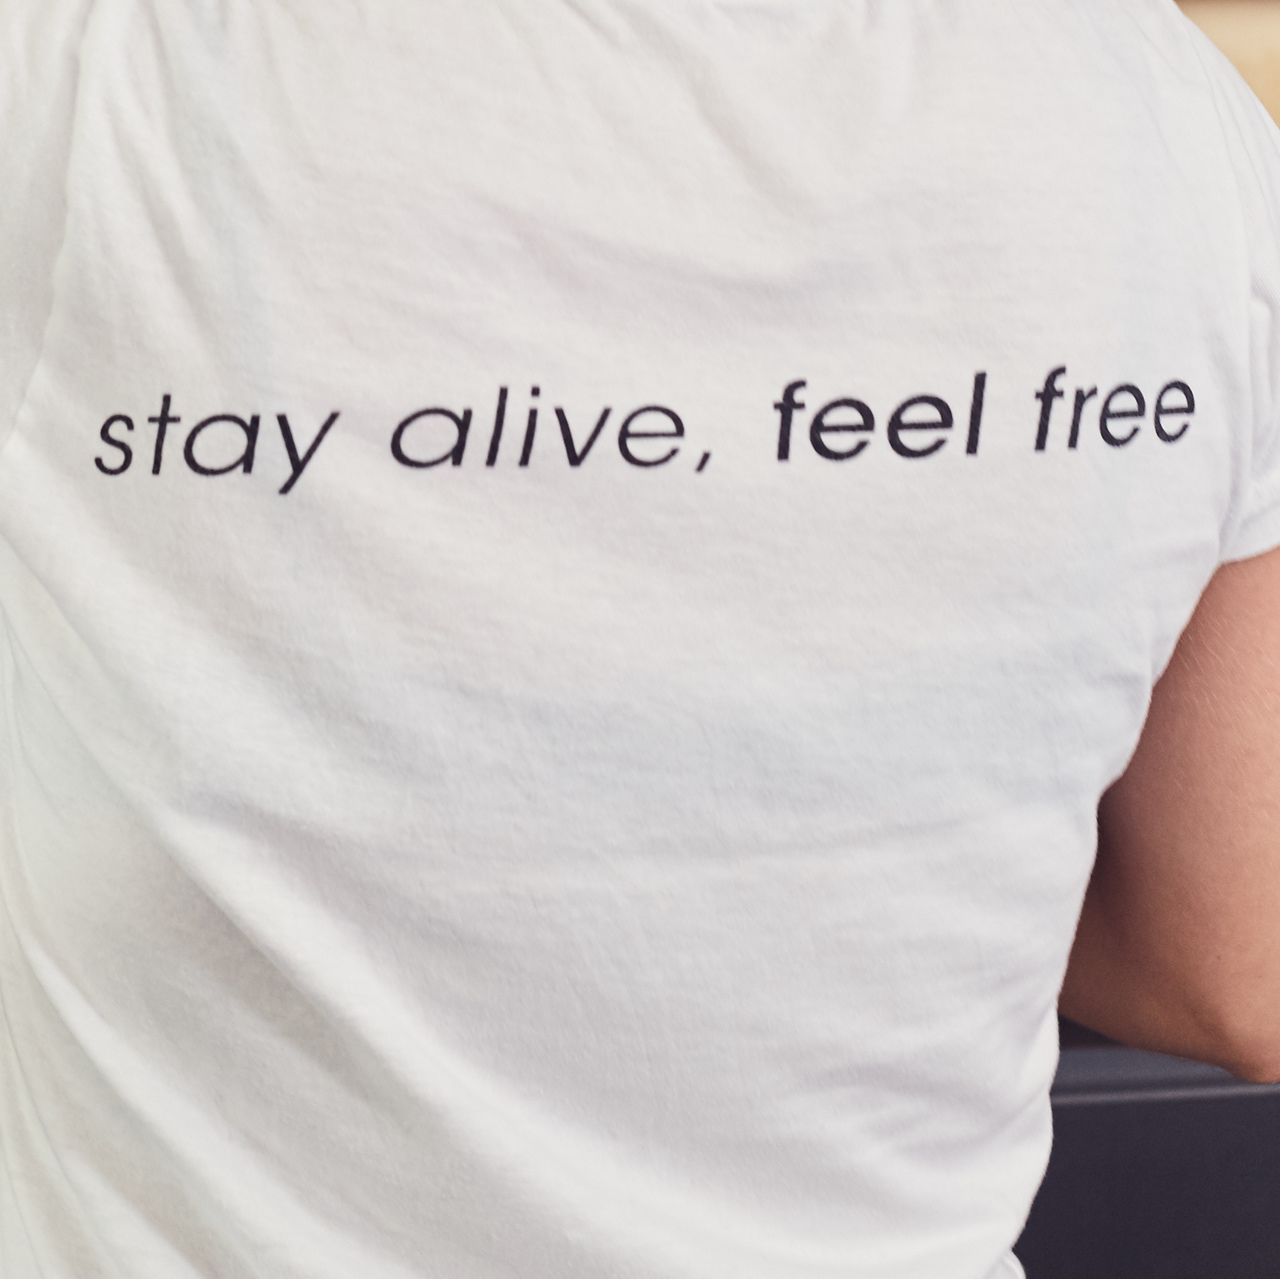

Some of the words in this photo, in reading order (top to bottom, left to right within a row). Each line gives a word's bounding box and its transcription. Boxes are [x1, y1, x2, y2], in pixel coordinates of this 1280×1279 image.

[93, 393, 341, 495] stay
[389, 385, 712, 472] alive,
[772, 371, 987, 461] feel
[1034, 365, 1196, 451] free
